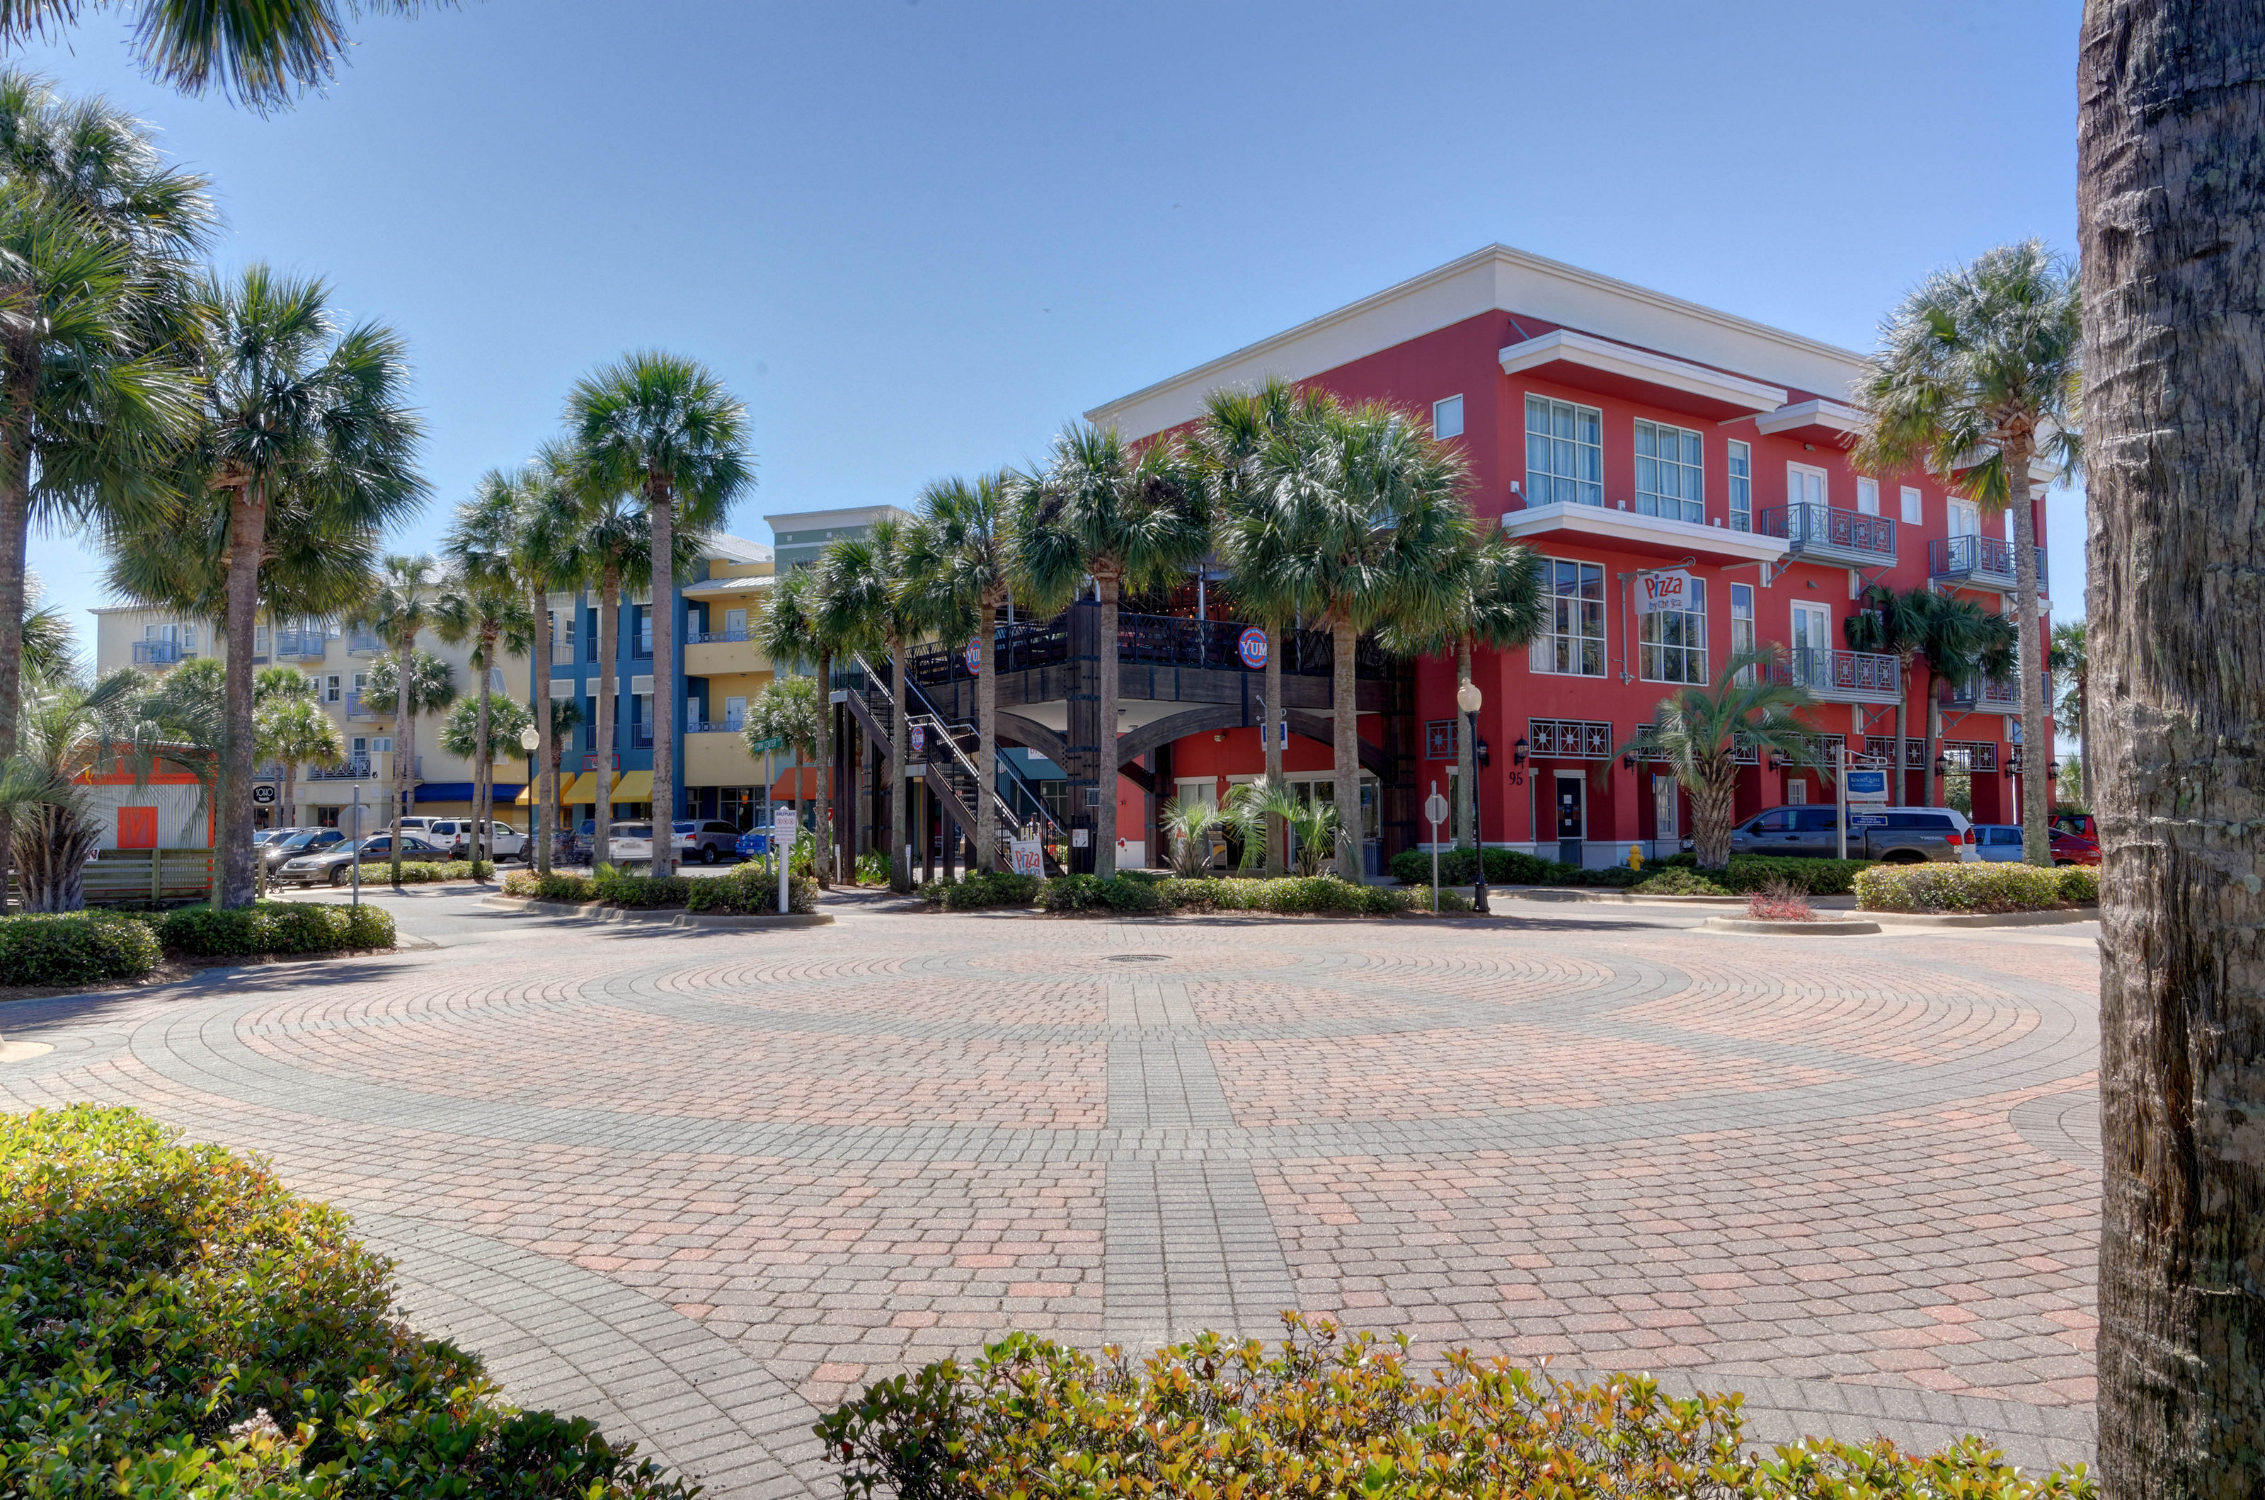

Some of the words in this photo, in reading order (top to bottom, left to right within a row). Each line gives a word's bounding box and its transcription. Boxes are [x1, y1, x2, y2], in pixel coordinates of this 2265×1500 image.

[1645, 574, 1683, 599] Pizza
[1509, 771, 1523, 786] 95
[1015, 847, 1040, 869] Pizza
